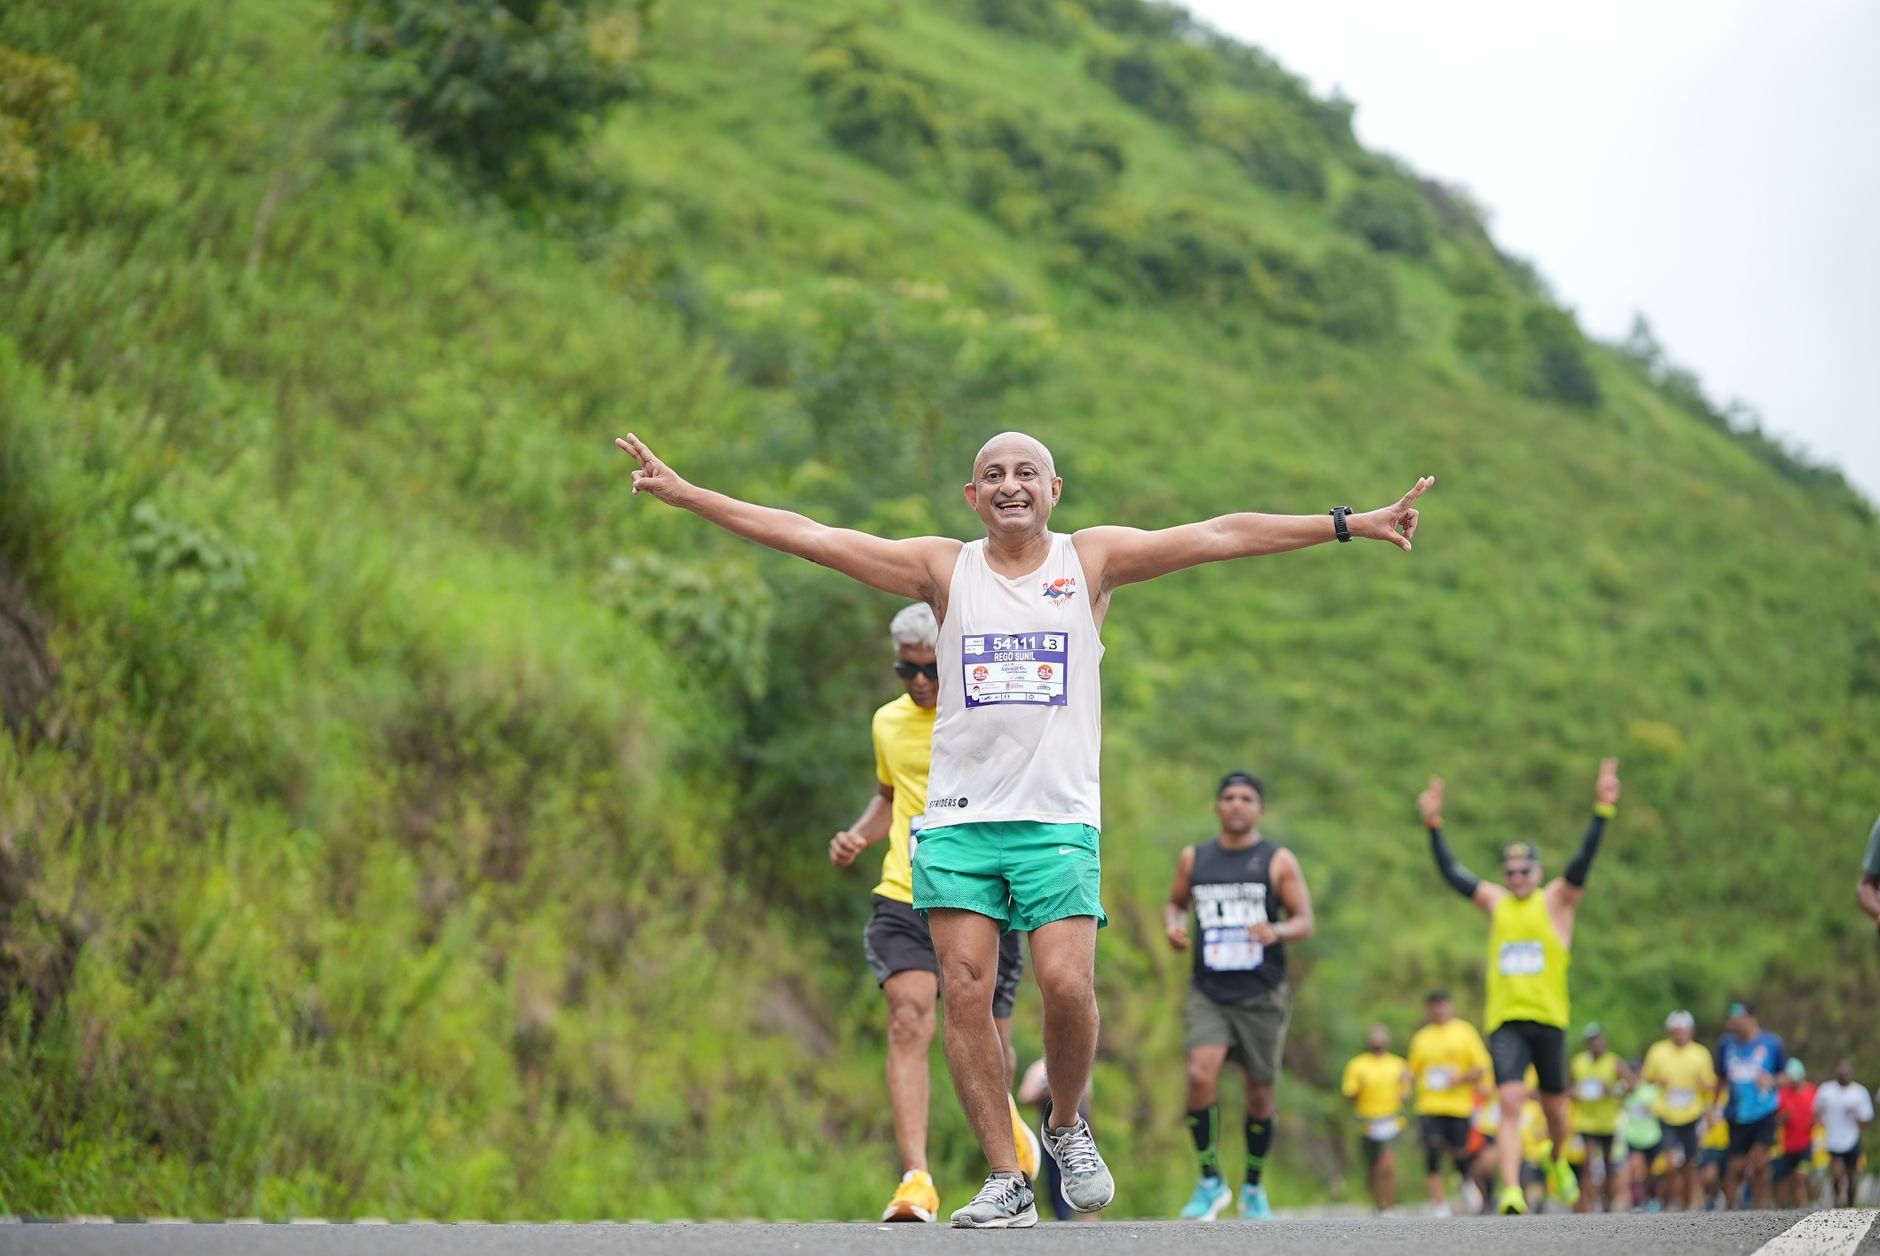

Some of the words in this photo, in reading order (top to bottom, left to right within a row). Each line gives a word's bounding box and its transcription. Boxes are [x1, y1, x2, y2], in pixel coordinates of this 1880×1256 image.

[993, 636, 1036, 650] 54111
[994, 652, 1014, 662] REGO
[1015, 651, 1036, 661] SUNIL
